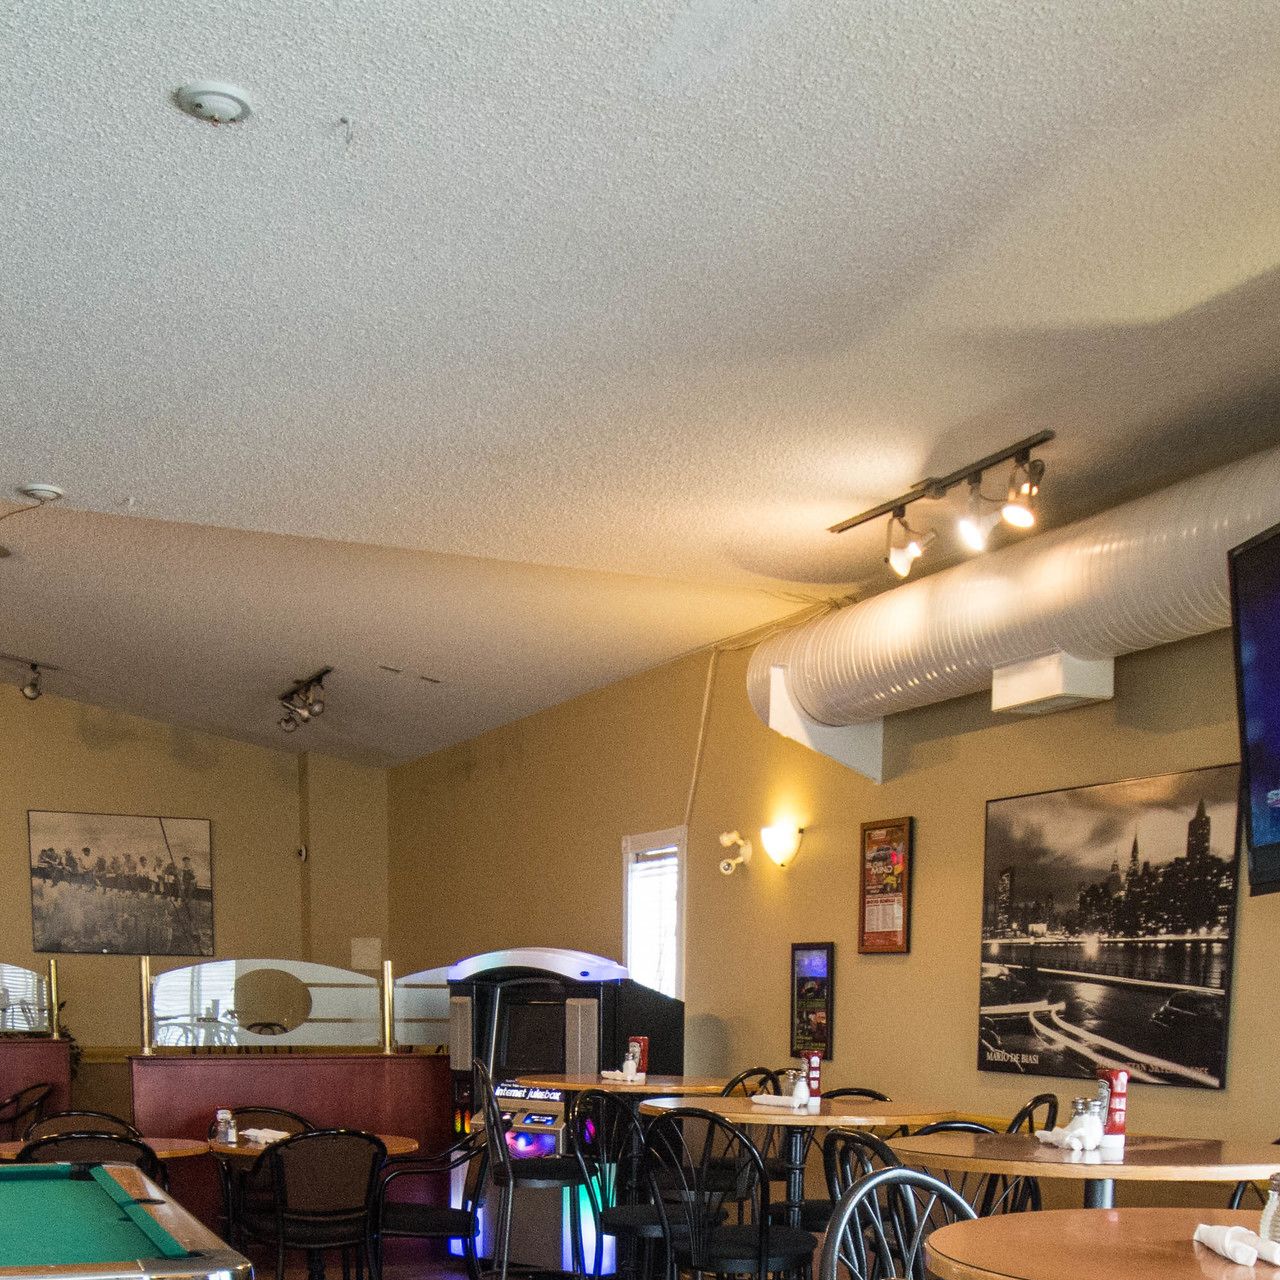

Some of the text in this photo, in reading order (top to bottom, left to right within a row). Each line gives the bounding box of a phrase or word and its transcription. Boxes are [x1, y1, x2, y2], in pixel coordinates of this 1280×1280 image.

[986, 1051, 1008, 1062] MARIO
[494, 1086, 562, 1101] internet jukebox
